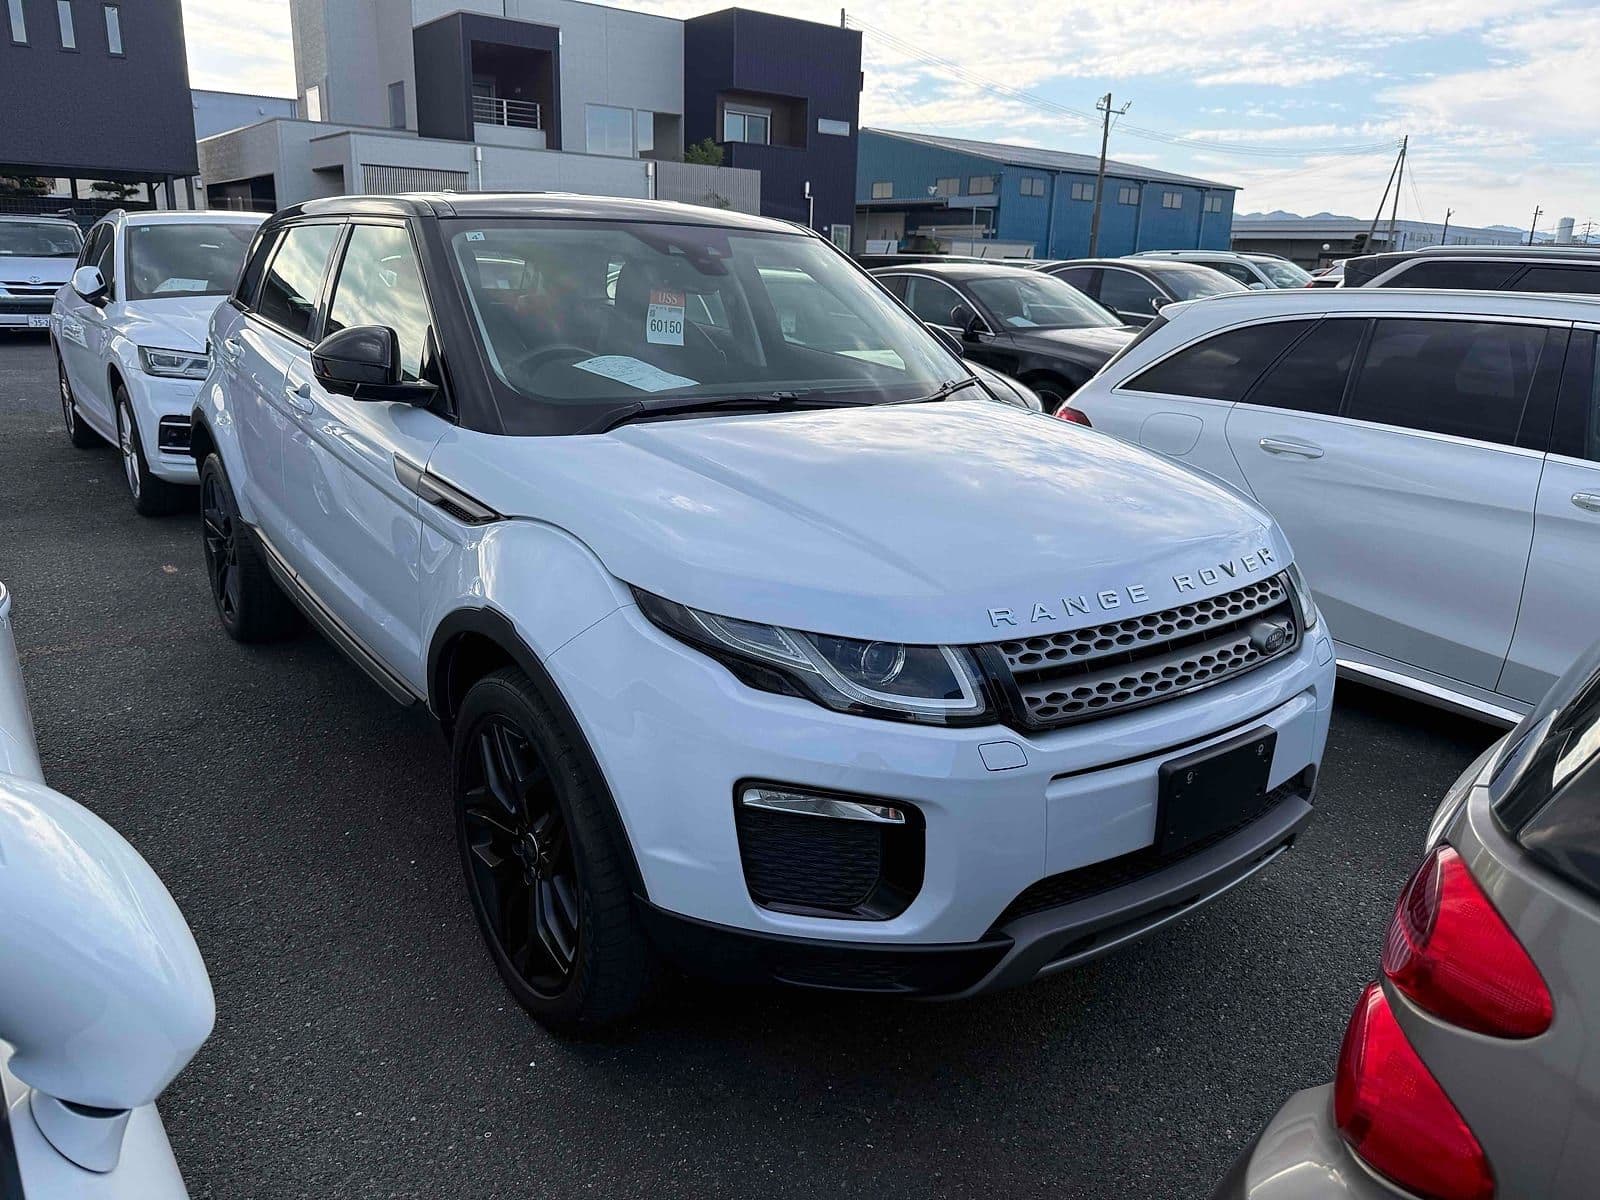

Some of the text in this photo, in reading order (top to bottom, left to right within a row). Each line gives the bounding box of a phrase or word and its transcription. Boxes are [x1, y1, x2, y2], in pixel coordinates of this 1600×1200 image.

[650, 319, 682, 334] 60150
[987, 547, 1275, 628] RANGE ROVER
